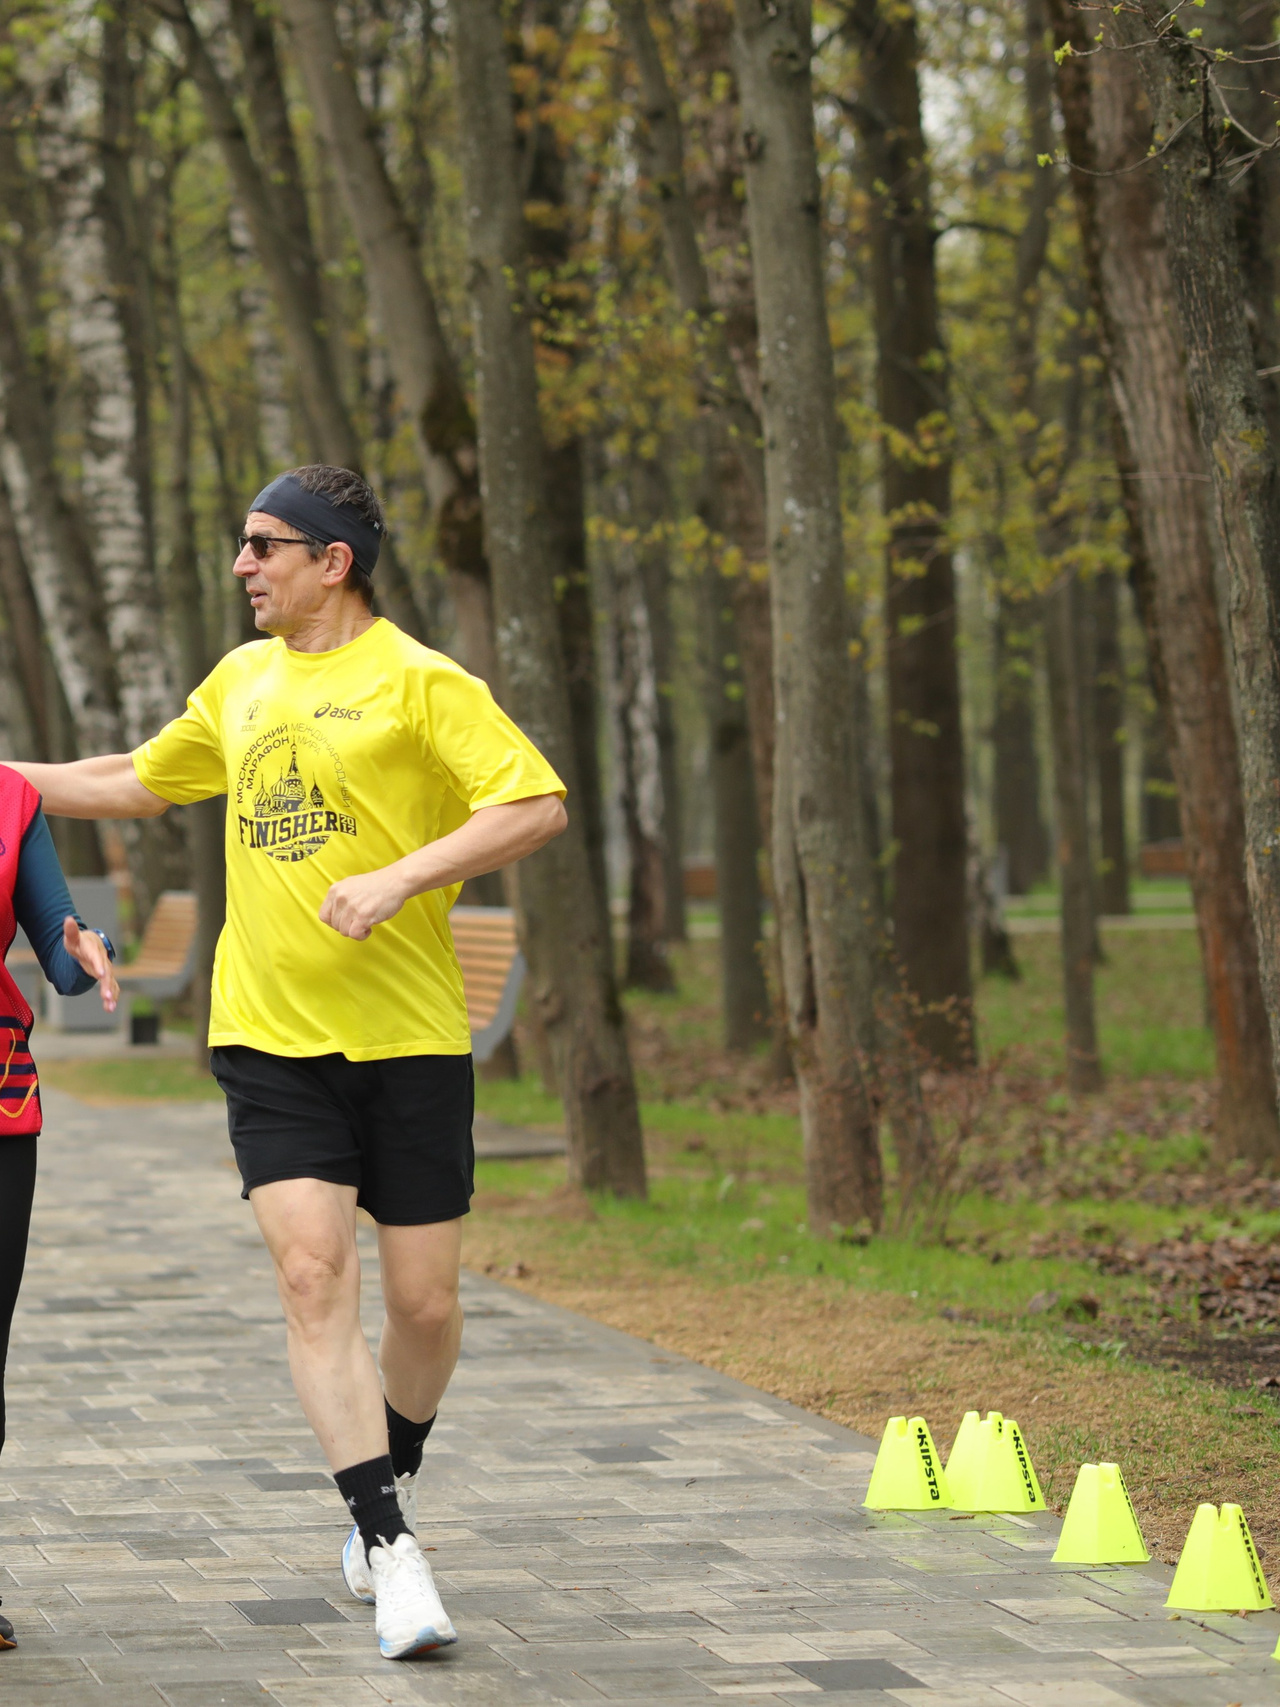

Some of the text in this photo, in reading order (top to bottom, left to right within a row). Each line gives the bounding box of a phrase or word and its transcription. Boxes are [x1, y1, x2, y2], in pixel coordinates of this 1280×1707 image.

[329, 707, 364, 721] asics
[237, 723, 353, 808] МОСКОВСКИЙ МЕЖДУНАРОДНЫЙ
[246, 735, 321, 790] МАРАФОН МИРА
[238, 811, 339, 849] FINISHER
